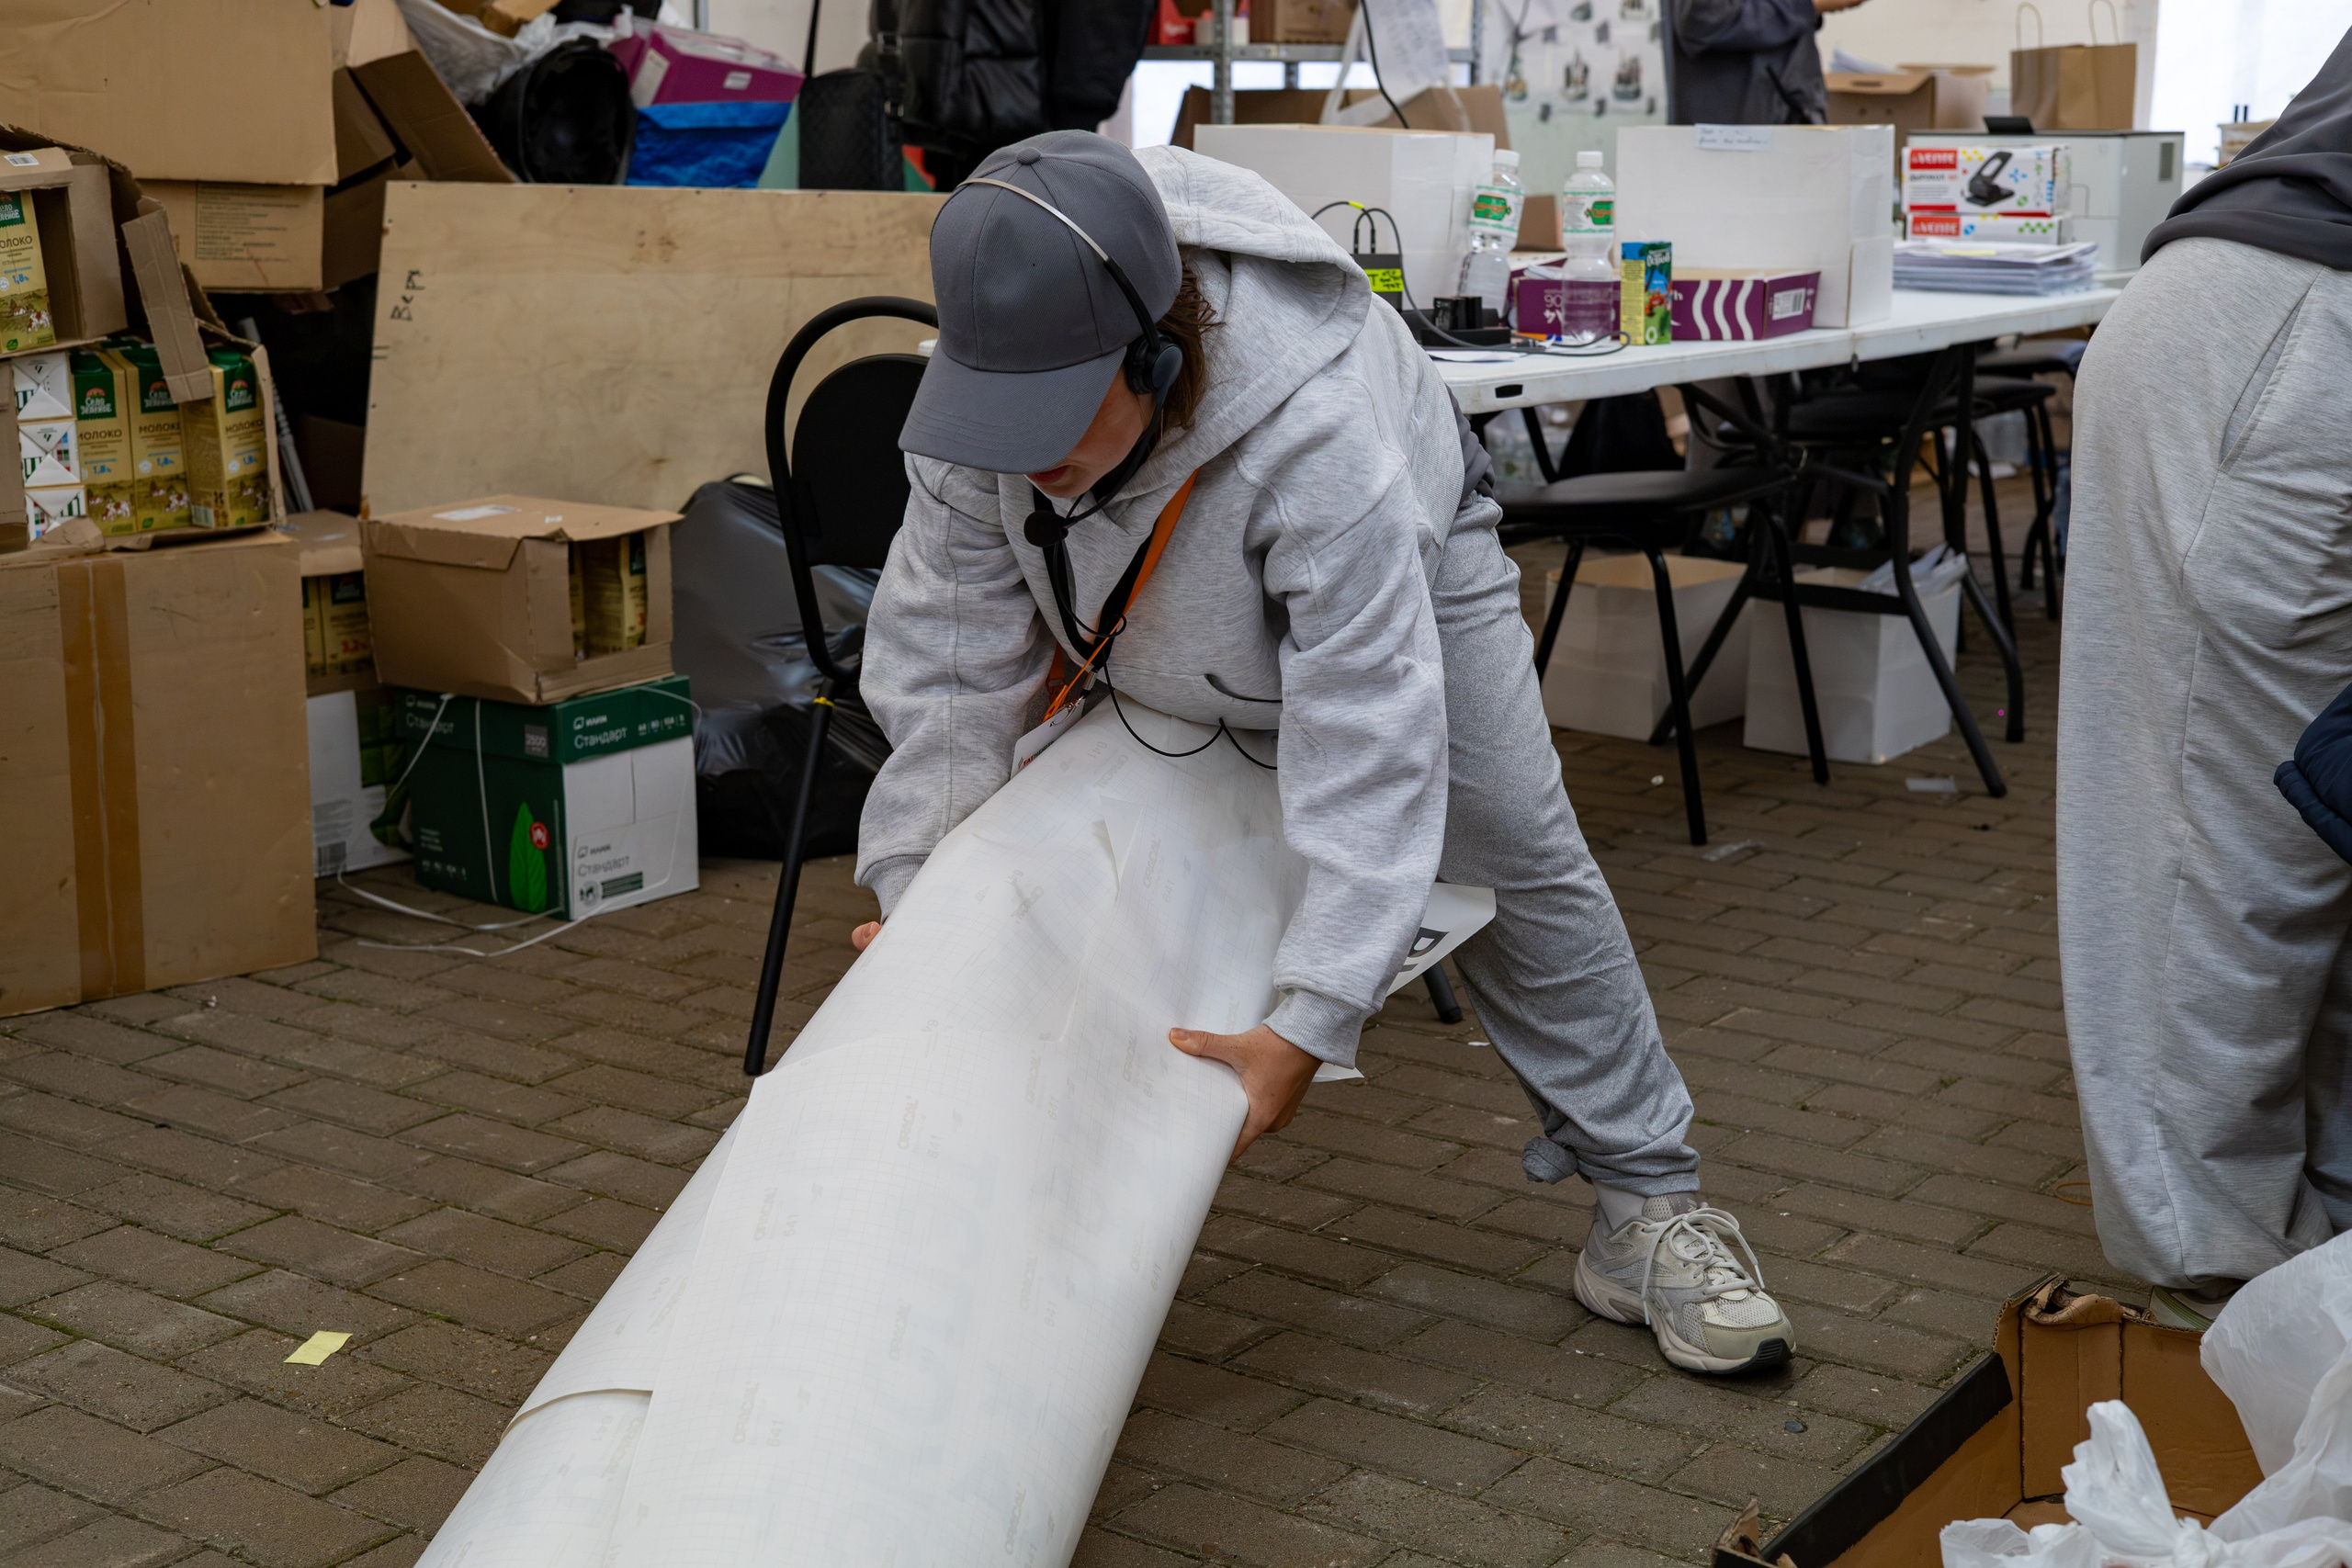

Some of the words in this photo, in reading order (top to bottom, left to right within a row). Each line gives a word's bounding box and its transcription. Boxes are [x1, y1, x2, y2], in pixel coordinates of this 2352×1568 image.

[0, 235, 33, 249] ОЛОКО
[573, 727, 628, 750] Стандарт
[926, 1134, 944, 1159] 641
